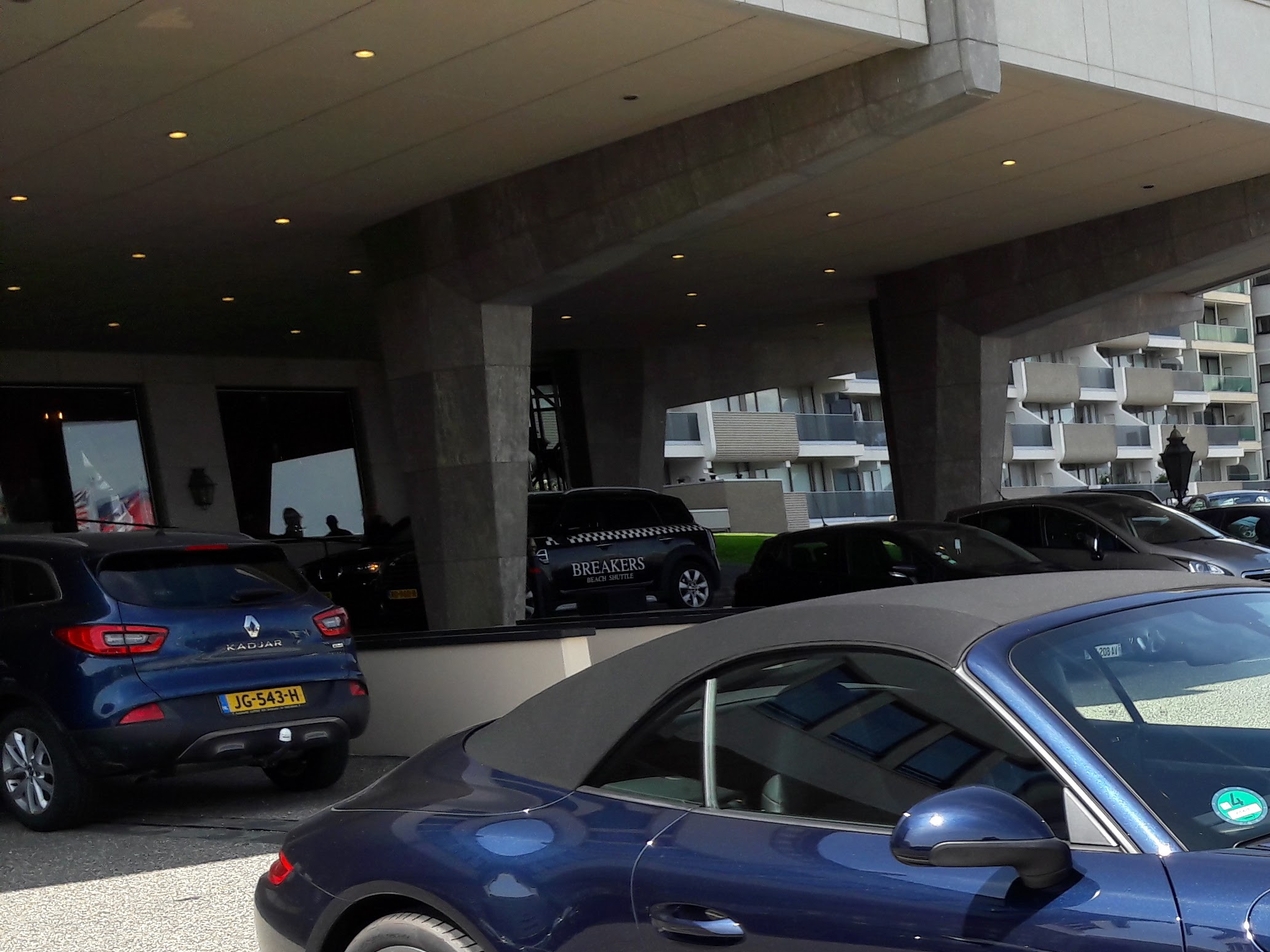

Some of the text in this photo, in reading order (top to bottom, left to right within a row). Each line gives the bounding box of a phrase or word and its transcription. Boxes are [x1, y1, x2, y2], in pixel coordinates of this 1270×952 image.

[571, 557, 645, 577] BREAKERS
[586, 573, 634, 584] BEACH SHUTTLE
[226, 639, 283, 651] KADJAR
[235, 689, 300, 709] JG-543-H
[1229, 792, 1244, 806] 4
